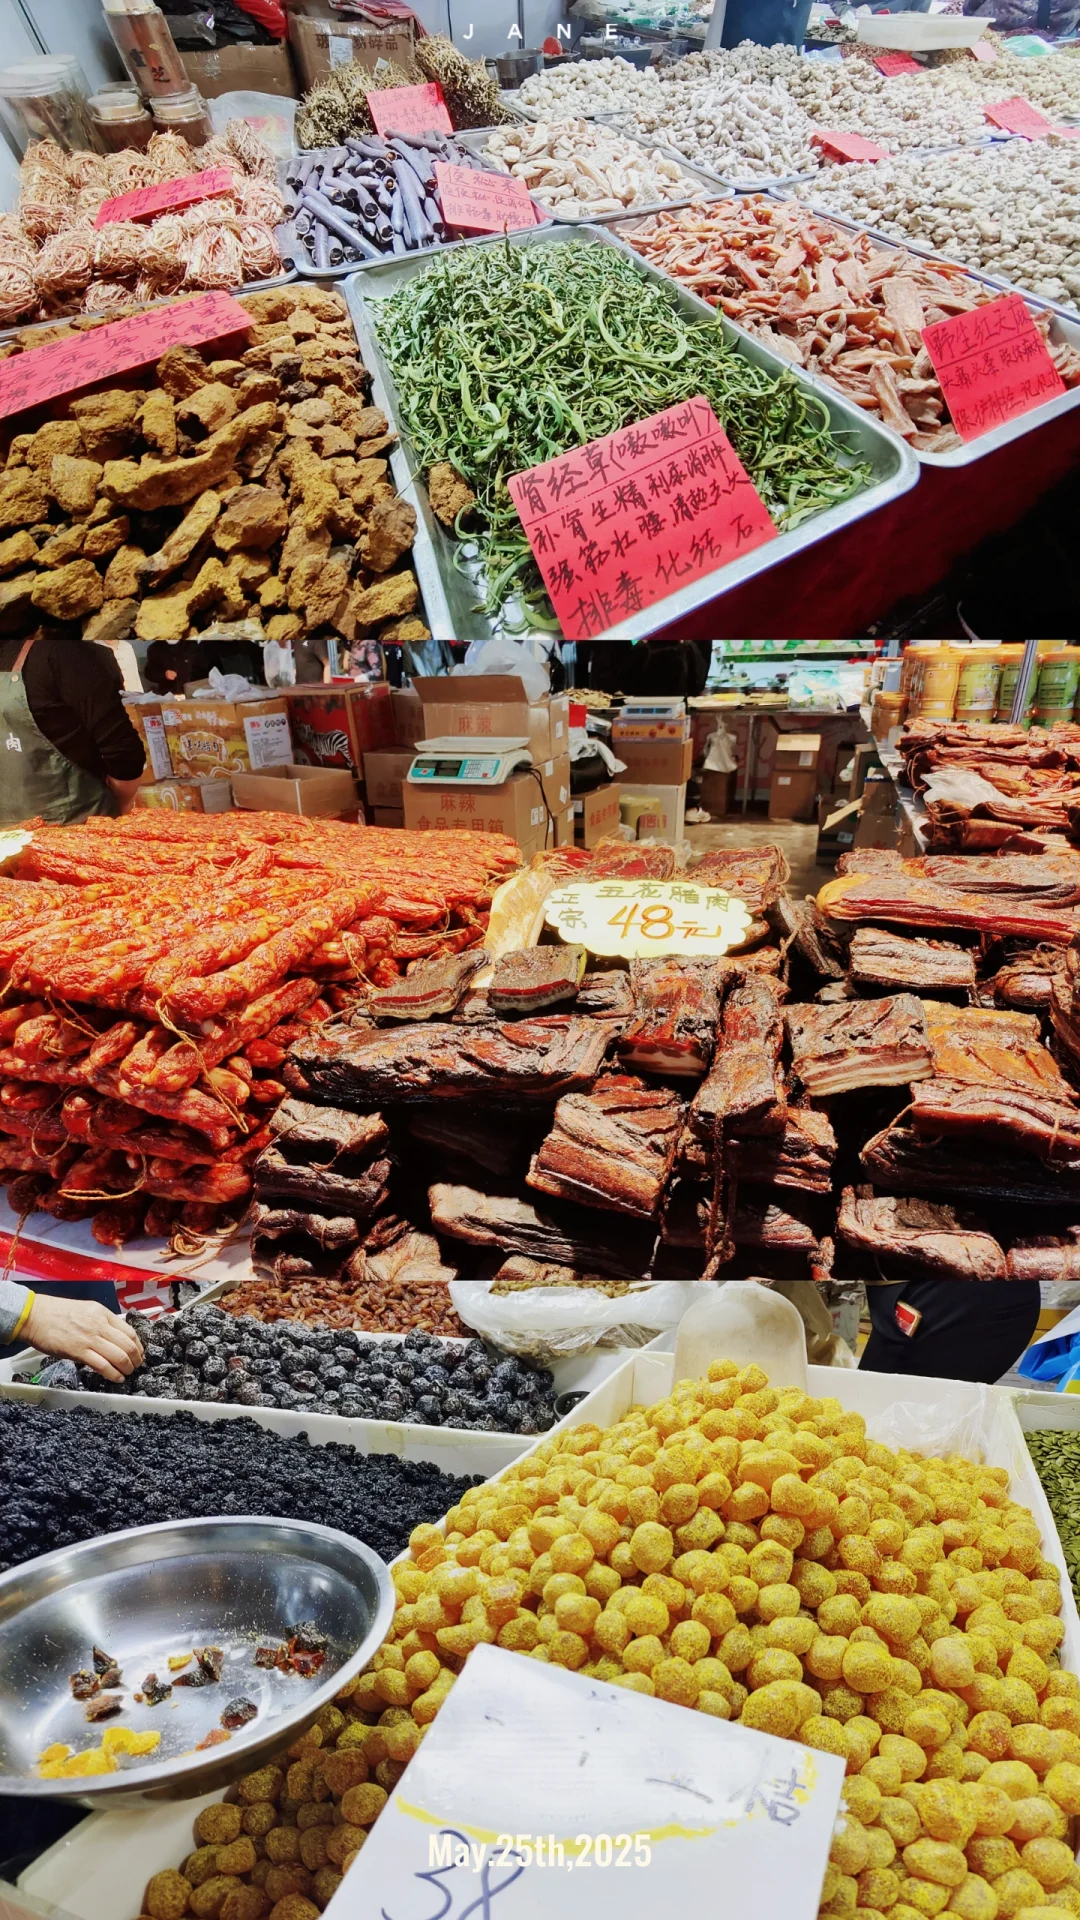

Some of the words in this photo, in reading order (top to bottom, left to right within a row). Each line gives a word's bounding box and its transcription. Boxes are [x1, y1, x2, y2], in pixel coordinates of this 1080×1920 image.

[315, 33, 398, 51] 玻易碎品
[926, 300, 1033, 362] 野生红天麻
[458, 715, 493, 733] 麻辣
[6, 732, 23, 752] 肉
[440, 794, 477, 812] 麻辣
[607, 902, 723, 940] 48元
